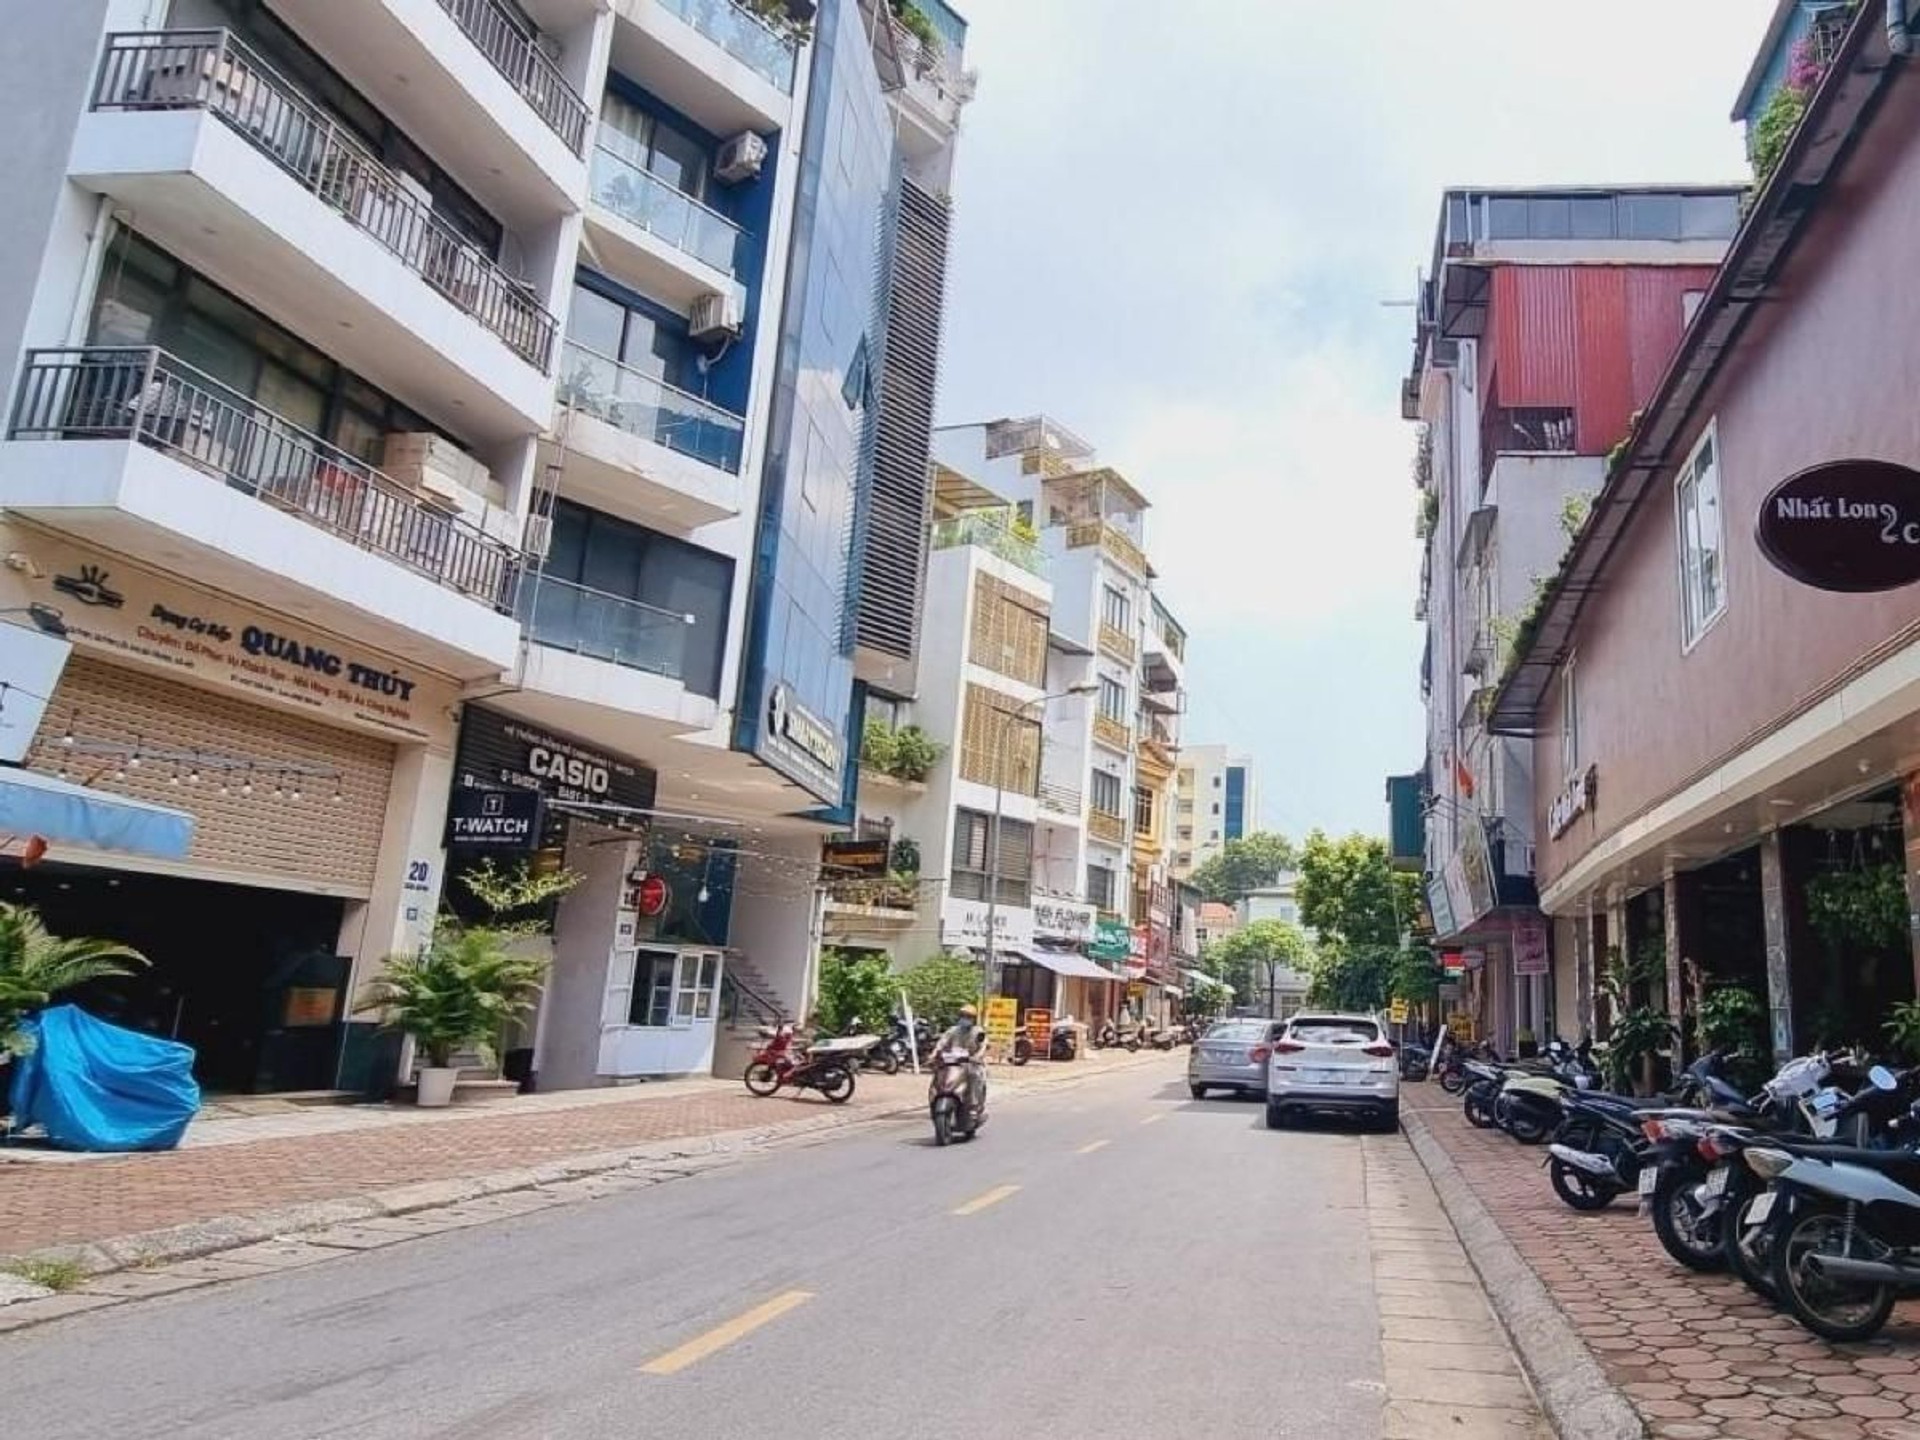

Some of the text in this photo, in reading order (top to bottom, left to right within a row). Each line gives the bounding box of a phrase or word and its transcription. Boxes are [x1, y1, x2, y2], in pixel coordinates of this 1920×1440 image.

[1777, 495, 1832, 519] Nhất
[241, 625, 342, 677] QUANG
[347, 663, 417, 702] THÚY
[529, 747, 609, 794] CASIO
[408, 860, 429, 882] 20
